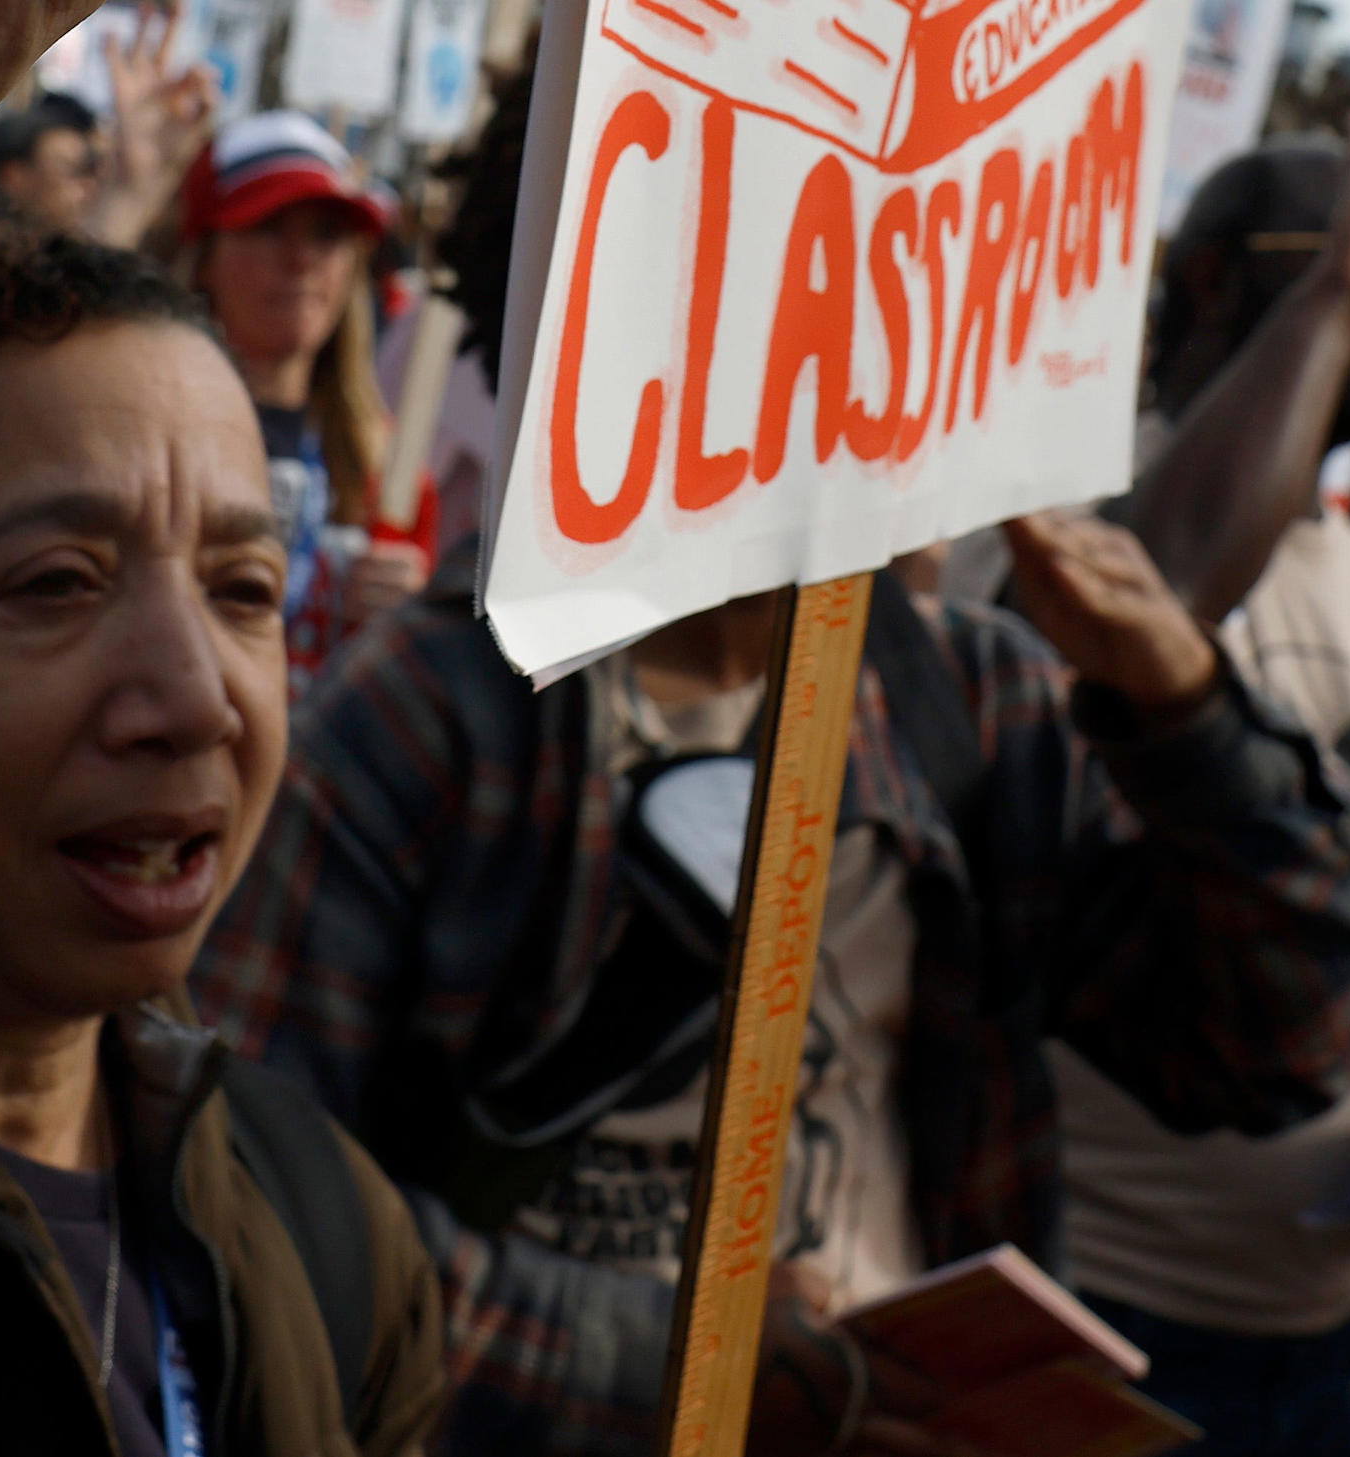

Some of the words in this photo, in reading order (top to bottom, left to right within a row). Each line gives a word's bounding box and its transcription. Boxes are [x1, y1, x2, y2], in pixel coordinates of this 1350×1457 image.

[549, 59, 1147, 545] CLASSROOM
[724, 1084, 785, 1282] HOME
[767, 804, 824, 1019] DEPOT
